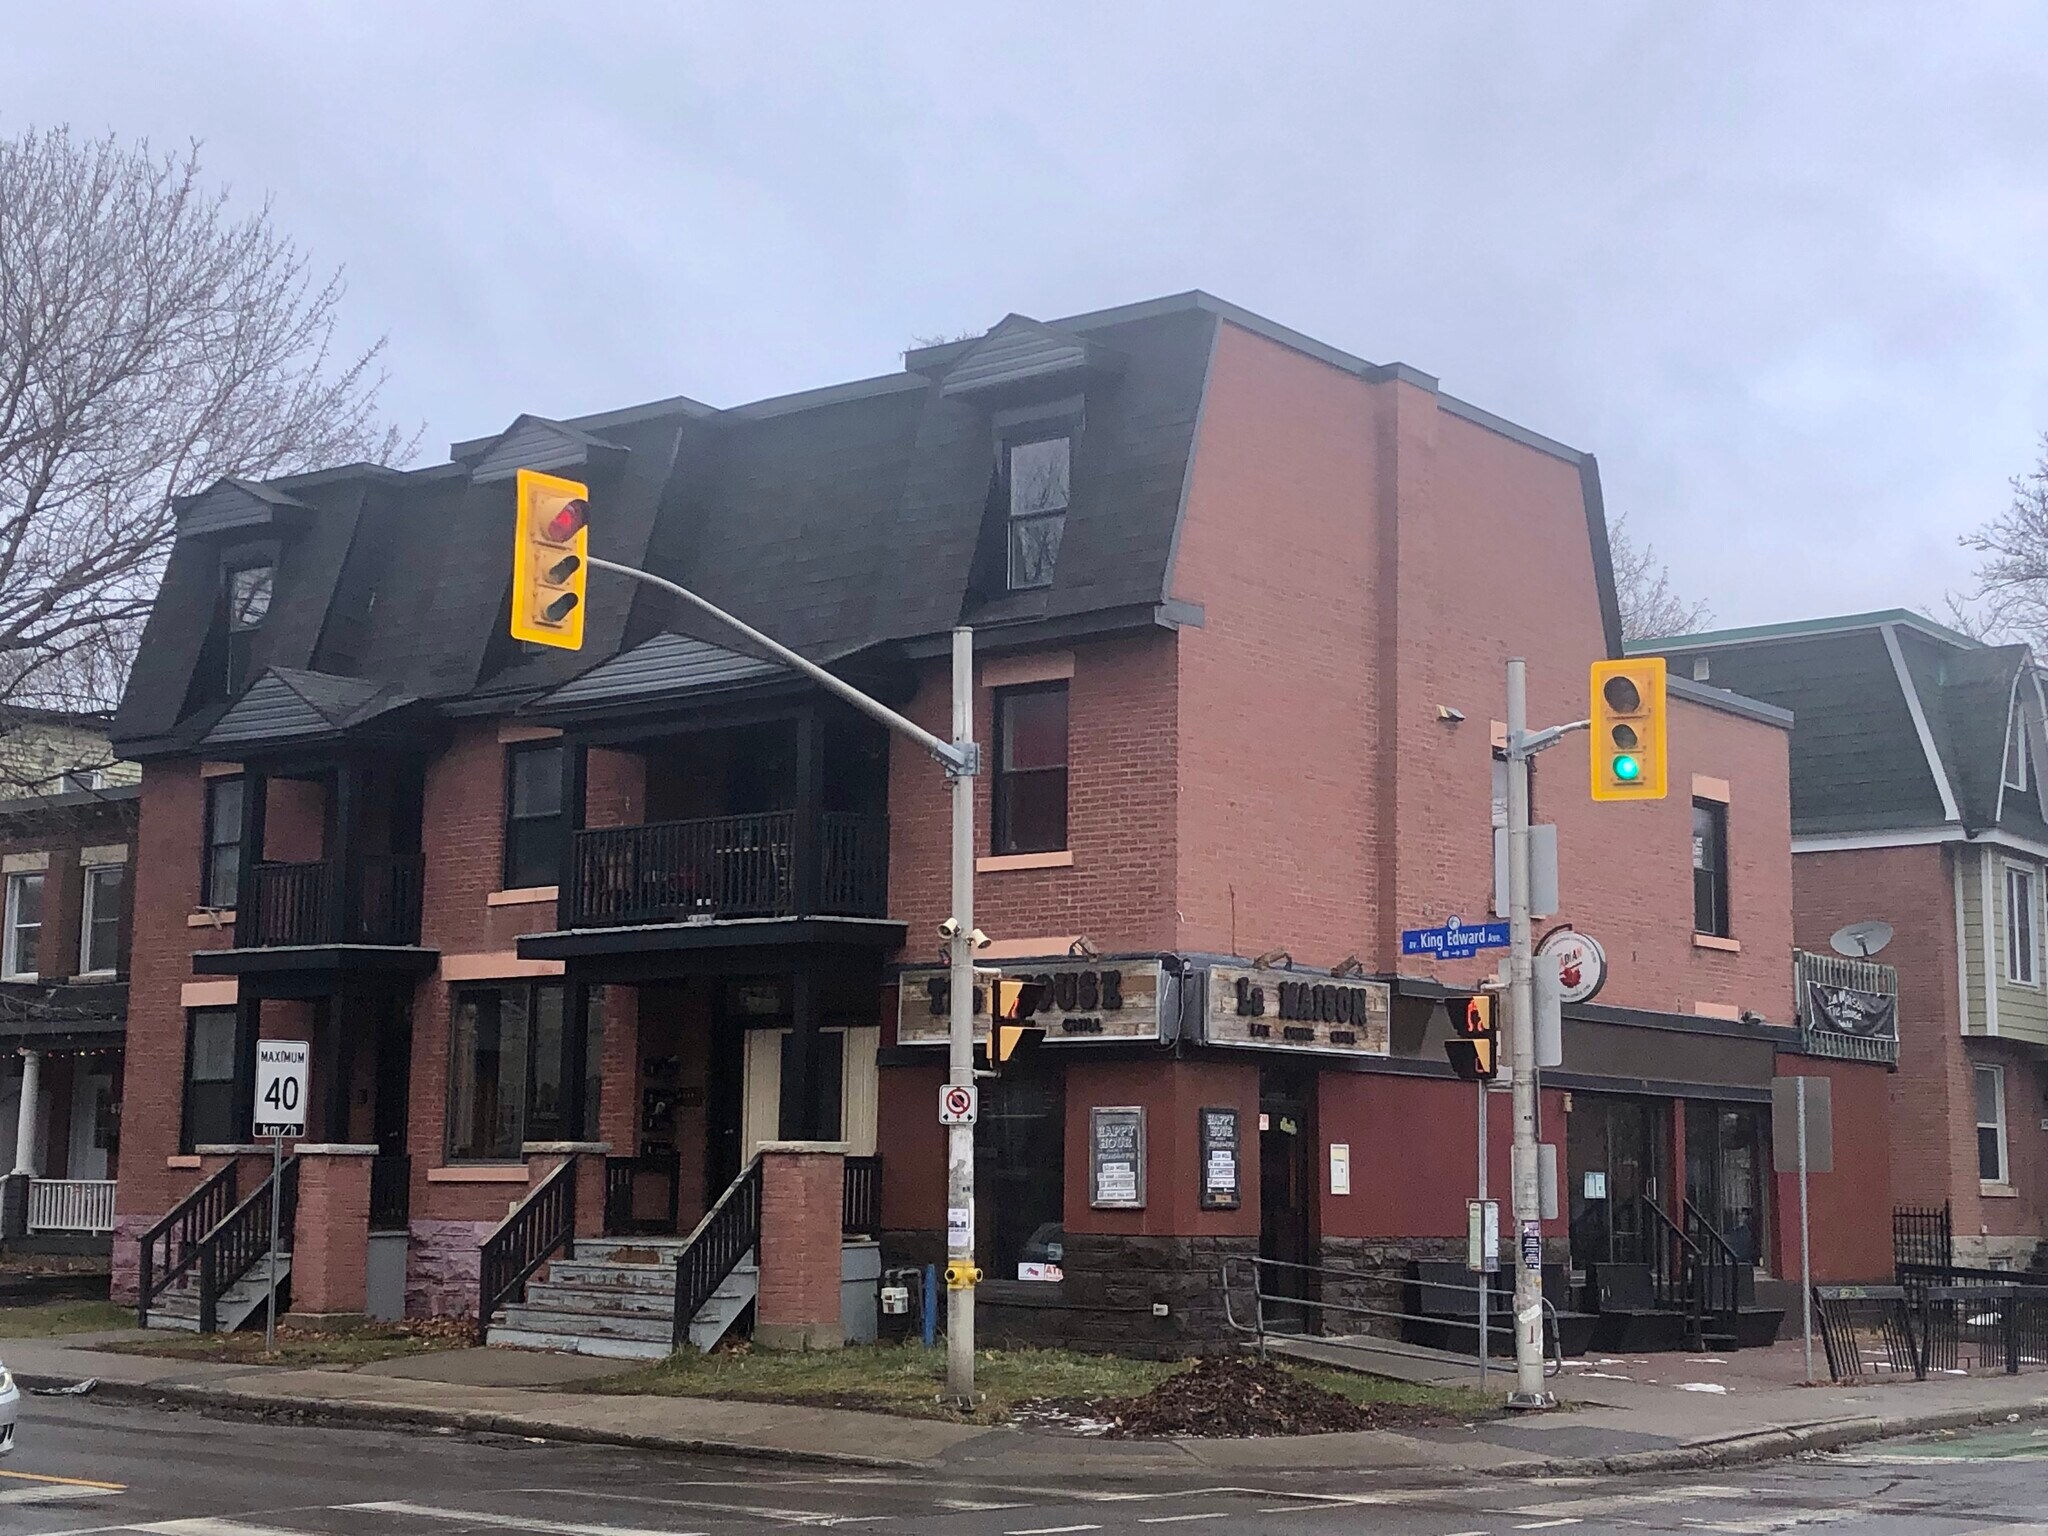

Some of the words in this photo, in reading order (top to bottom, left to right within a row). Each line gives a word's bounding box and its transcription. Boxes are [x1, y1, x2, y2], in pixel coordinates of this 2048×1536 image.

[1420, 931, 1443, 951] King
[1447, 926, 1486, 946] Edward
[261, 1051, 305, 1063] MAXIMUM
[264, 1076, 299, 1111] 40
[262, 1124, 297, 1136] km/h
[1096, 1124, 1136, 1138] HAPPY
